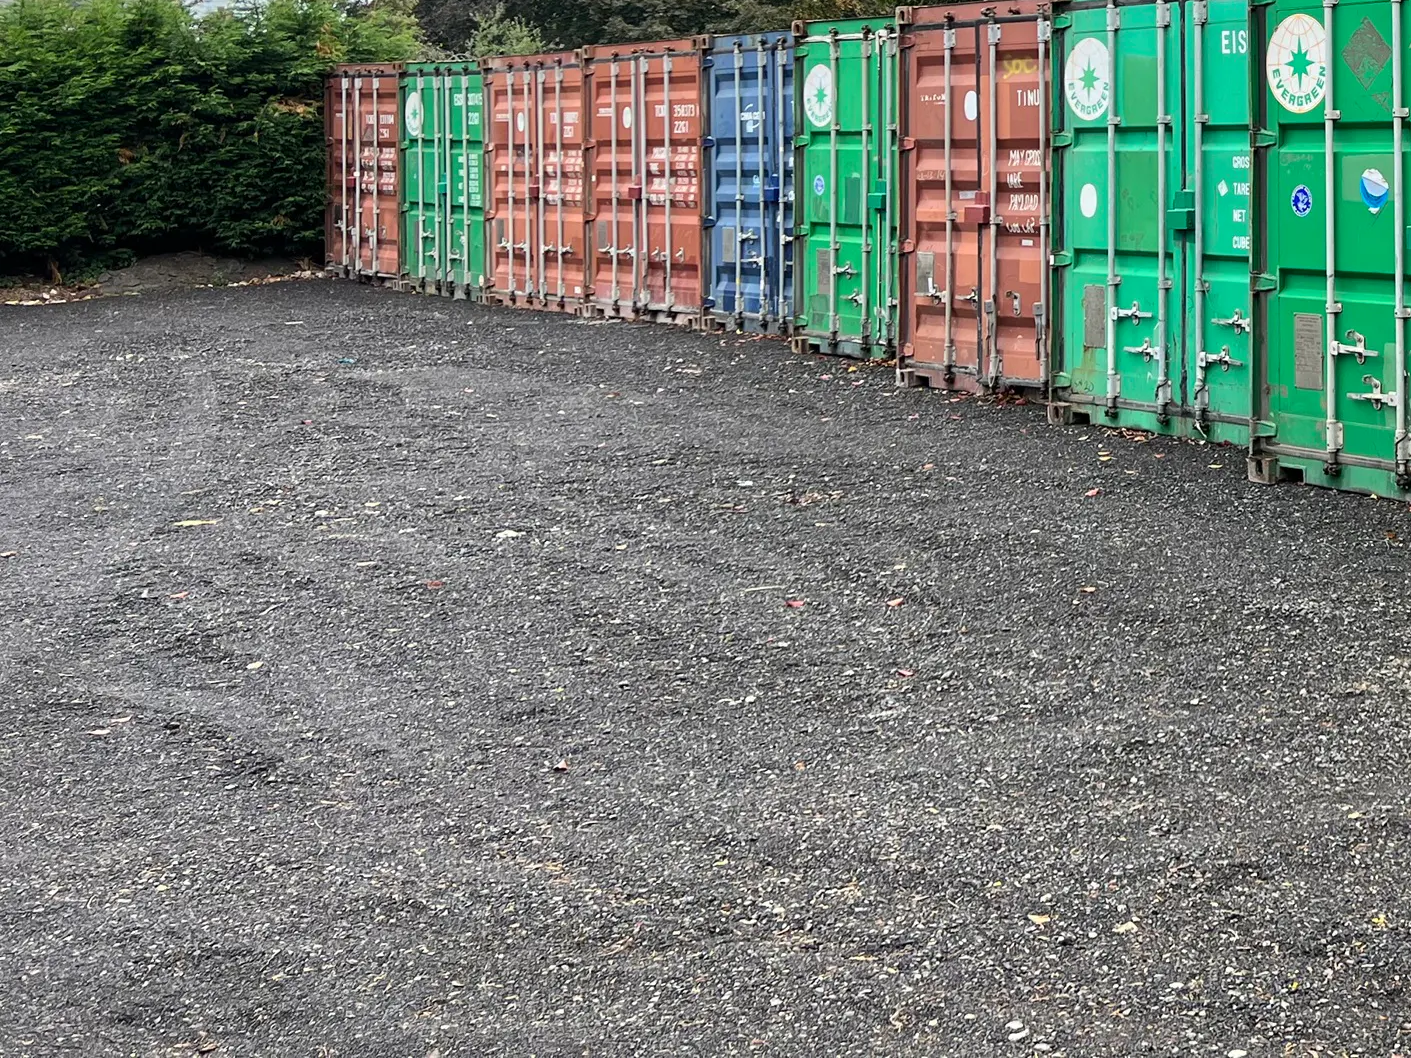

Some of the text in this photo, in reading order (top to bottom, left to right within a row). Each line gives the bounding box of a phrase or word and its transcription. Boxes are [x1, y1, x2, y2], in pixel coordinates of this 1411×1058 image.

[1221, 30, 1248, 54] EIS
[1272, 66, 1326, 107] EVERGREEN
[1068, 82, 1109, 115] EVERGREEN
[1233, 183, 1250, 196] TARE
[1233, 209, 1246, 223] NET
[1232, 236, 1250, 250] CUBE
